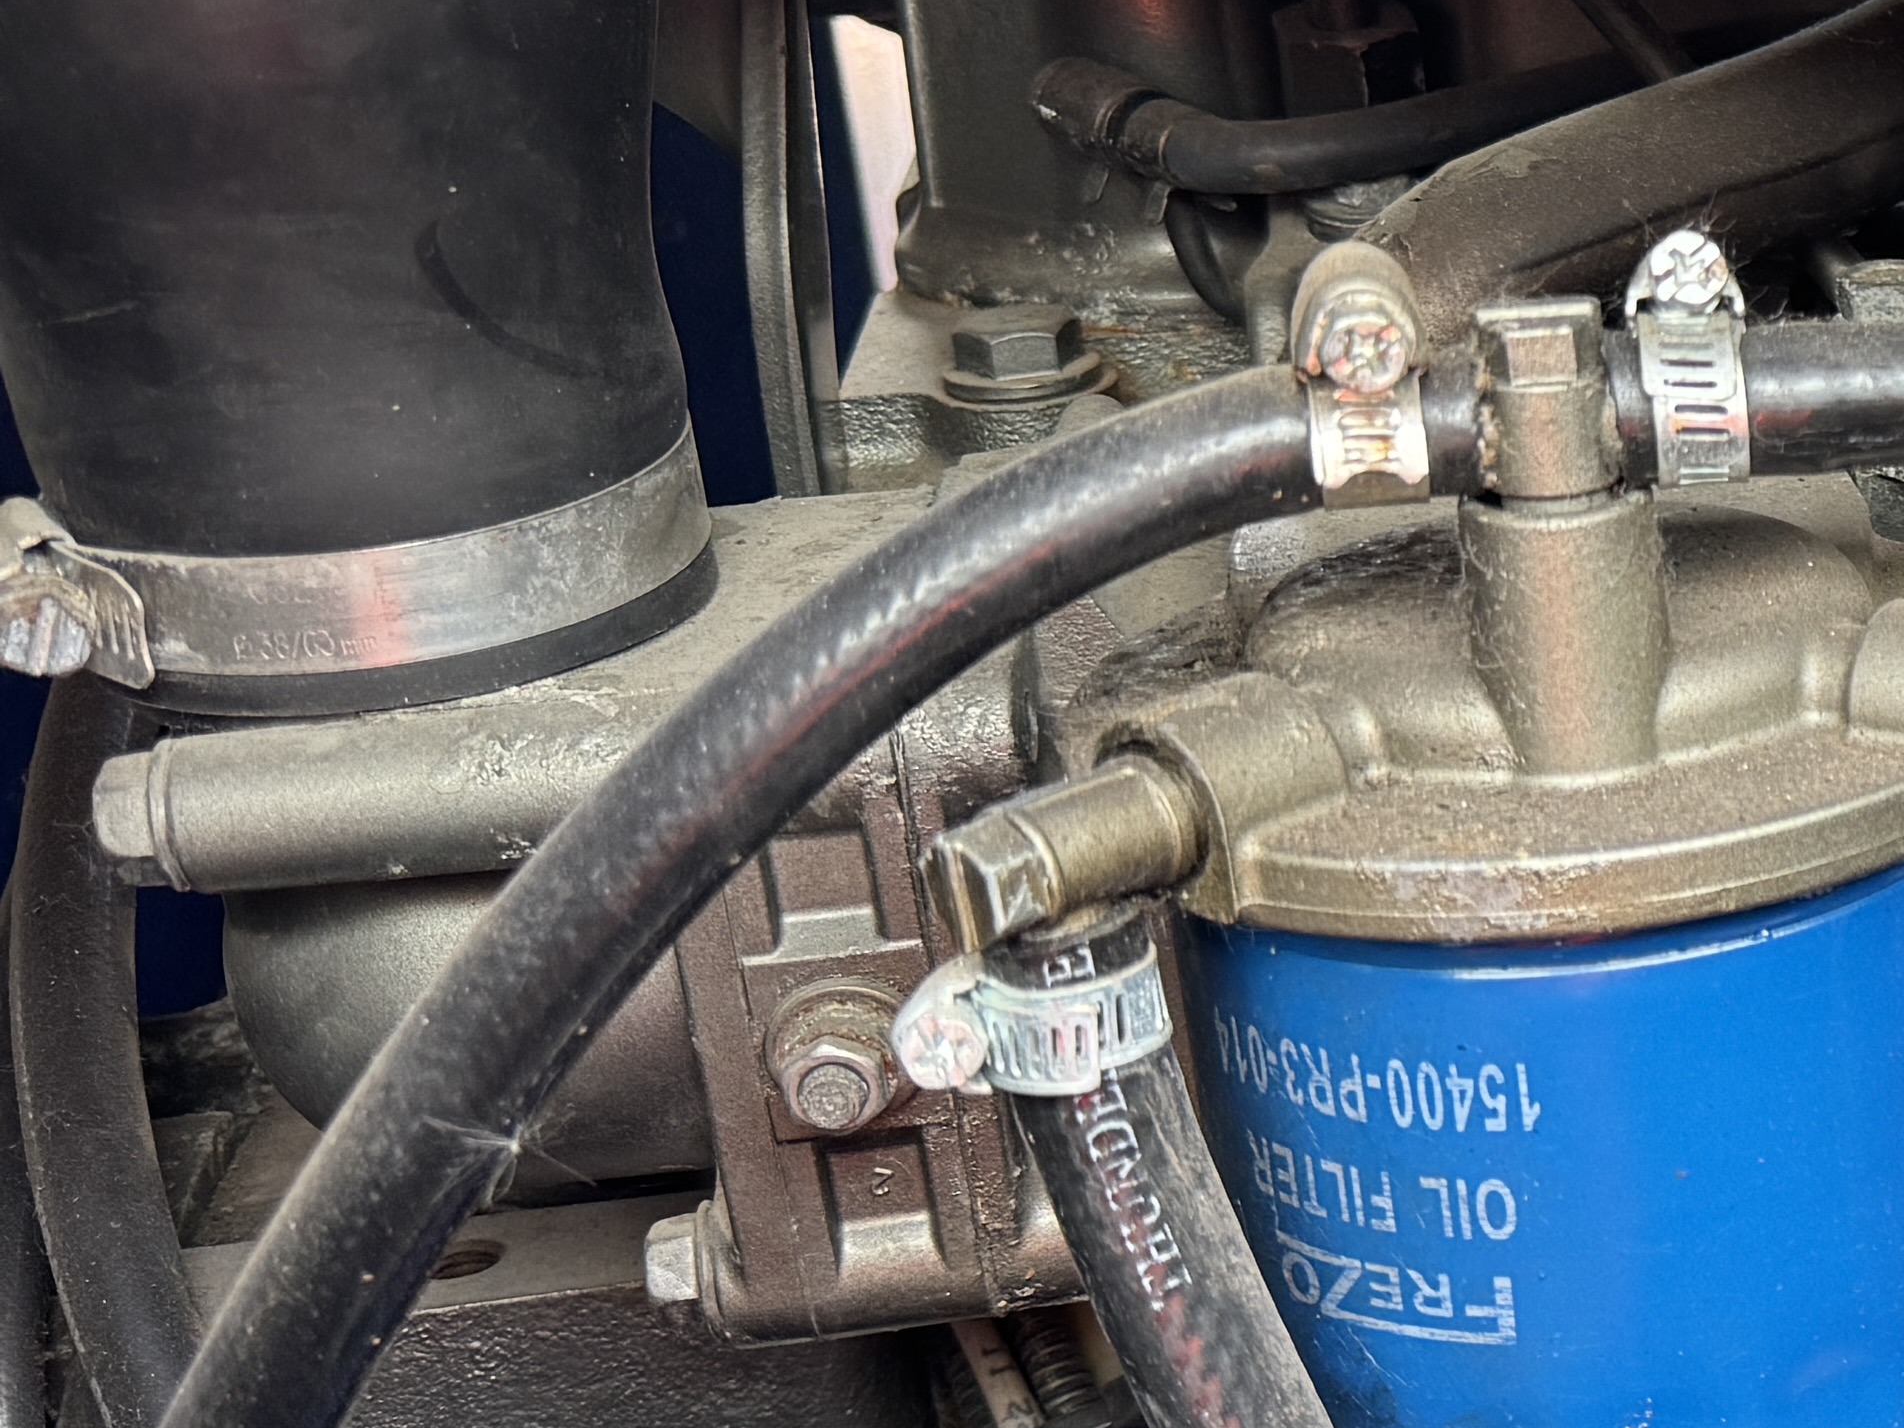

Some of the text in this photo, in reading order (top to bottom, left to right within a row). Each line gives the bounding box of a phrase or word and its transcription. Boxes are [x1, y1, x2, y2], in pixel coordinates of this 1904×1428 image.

[1214, 1005, 1542, 1132] 15400-PR3-014
[1073, 1068, 1193, 1312] THUNDE
[1247, 1127, 1517, 1241] OIL FILTER
[1276, 1234, 1517, 1346] FREZO
